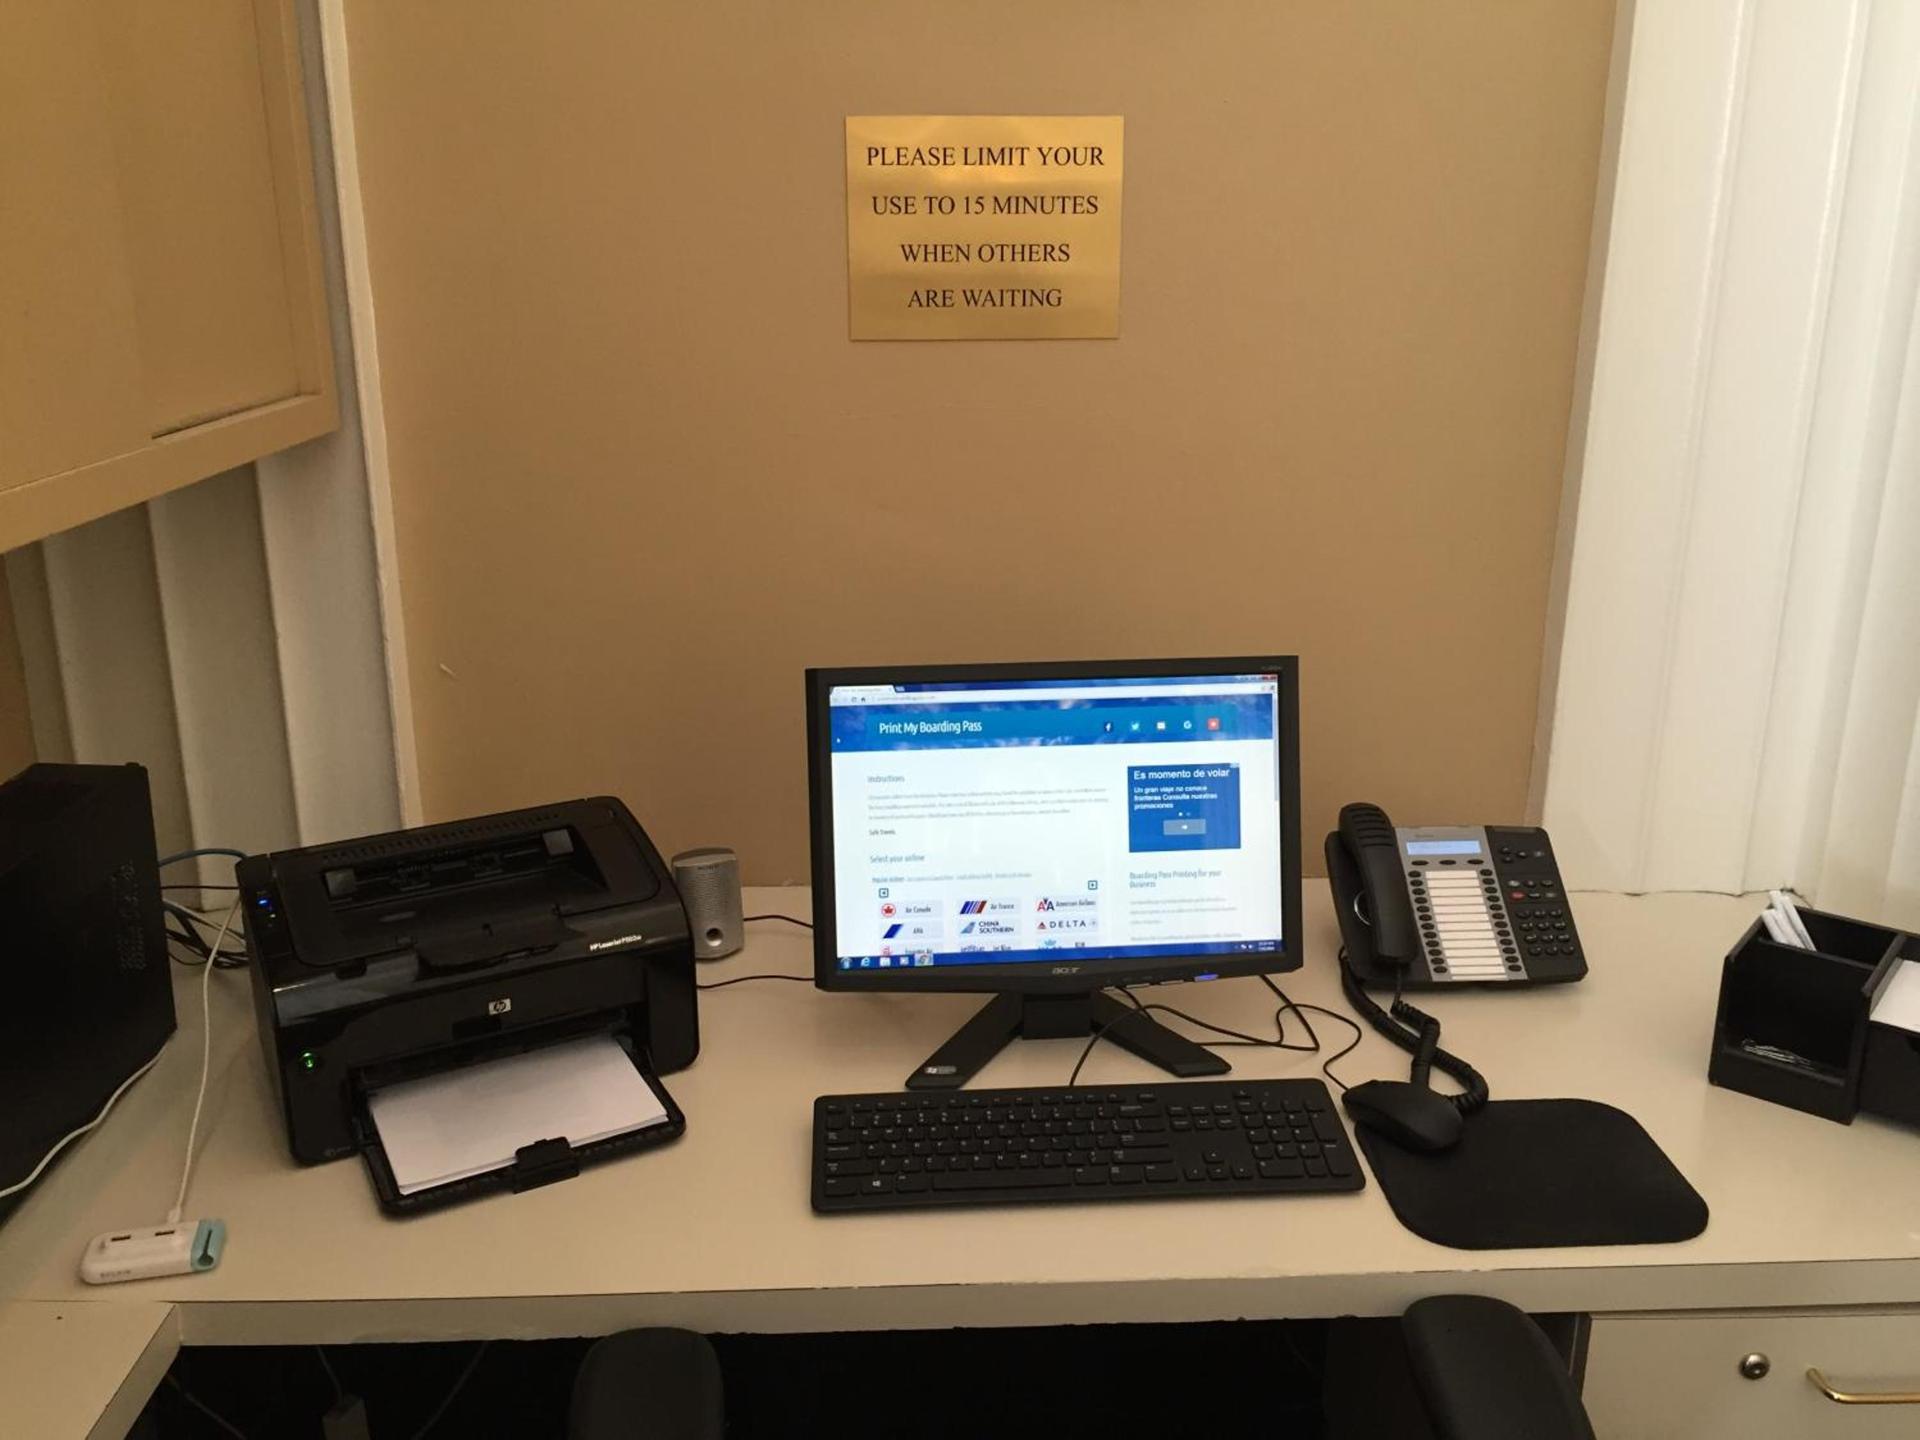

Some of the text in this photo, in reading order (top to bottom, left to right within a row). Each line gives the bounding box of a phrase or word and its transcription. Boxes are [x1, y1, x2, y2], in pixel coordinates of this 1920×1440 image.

[866, 146, 1105, 167] PLEASE LIMIT YOUR
[872, 195, 1099, 215] USE TO 15 MINUTES
[900, 242, 1071, 263] WHEN OTHERS
[907, 288, 1063, 308] ARE WAITING
[879, 719, 983, 736] Print My Boarding Pass
[1133, 767, 1230, 780] Es momento de volar
[978, 920, 1000, 928] CHINA
[979, 926, 1015, 934] SOUTHERN
[1049, 919, 1088, 930] DELTA
